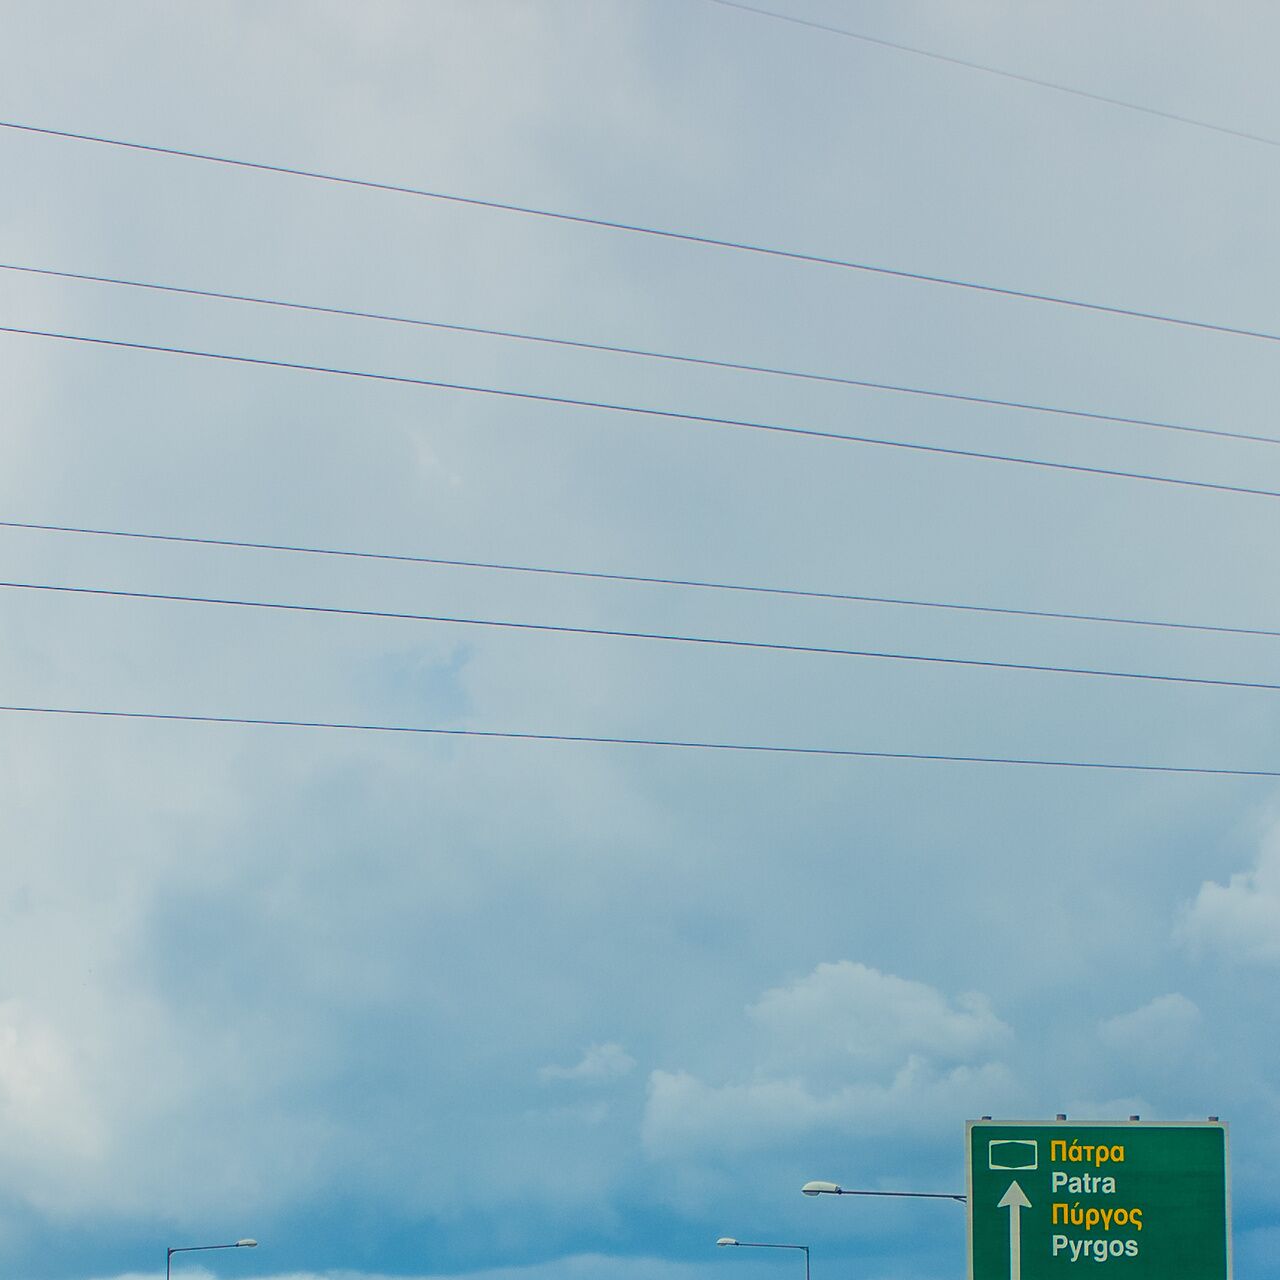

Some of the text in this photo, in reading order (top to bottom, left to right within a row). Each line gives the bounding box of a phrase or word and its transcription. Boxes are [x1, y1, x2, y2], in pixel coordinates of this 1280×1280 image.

[1050, 1138, 1125, 1168] Πάτρα
[1052, 1171, 1116, 1194] Patra
[1052, 1201, 1143, 1231] Πύργος
[1052, 1234, 1139, 1263] Pyrgos
